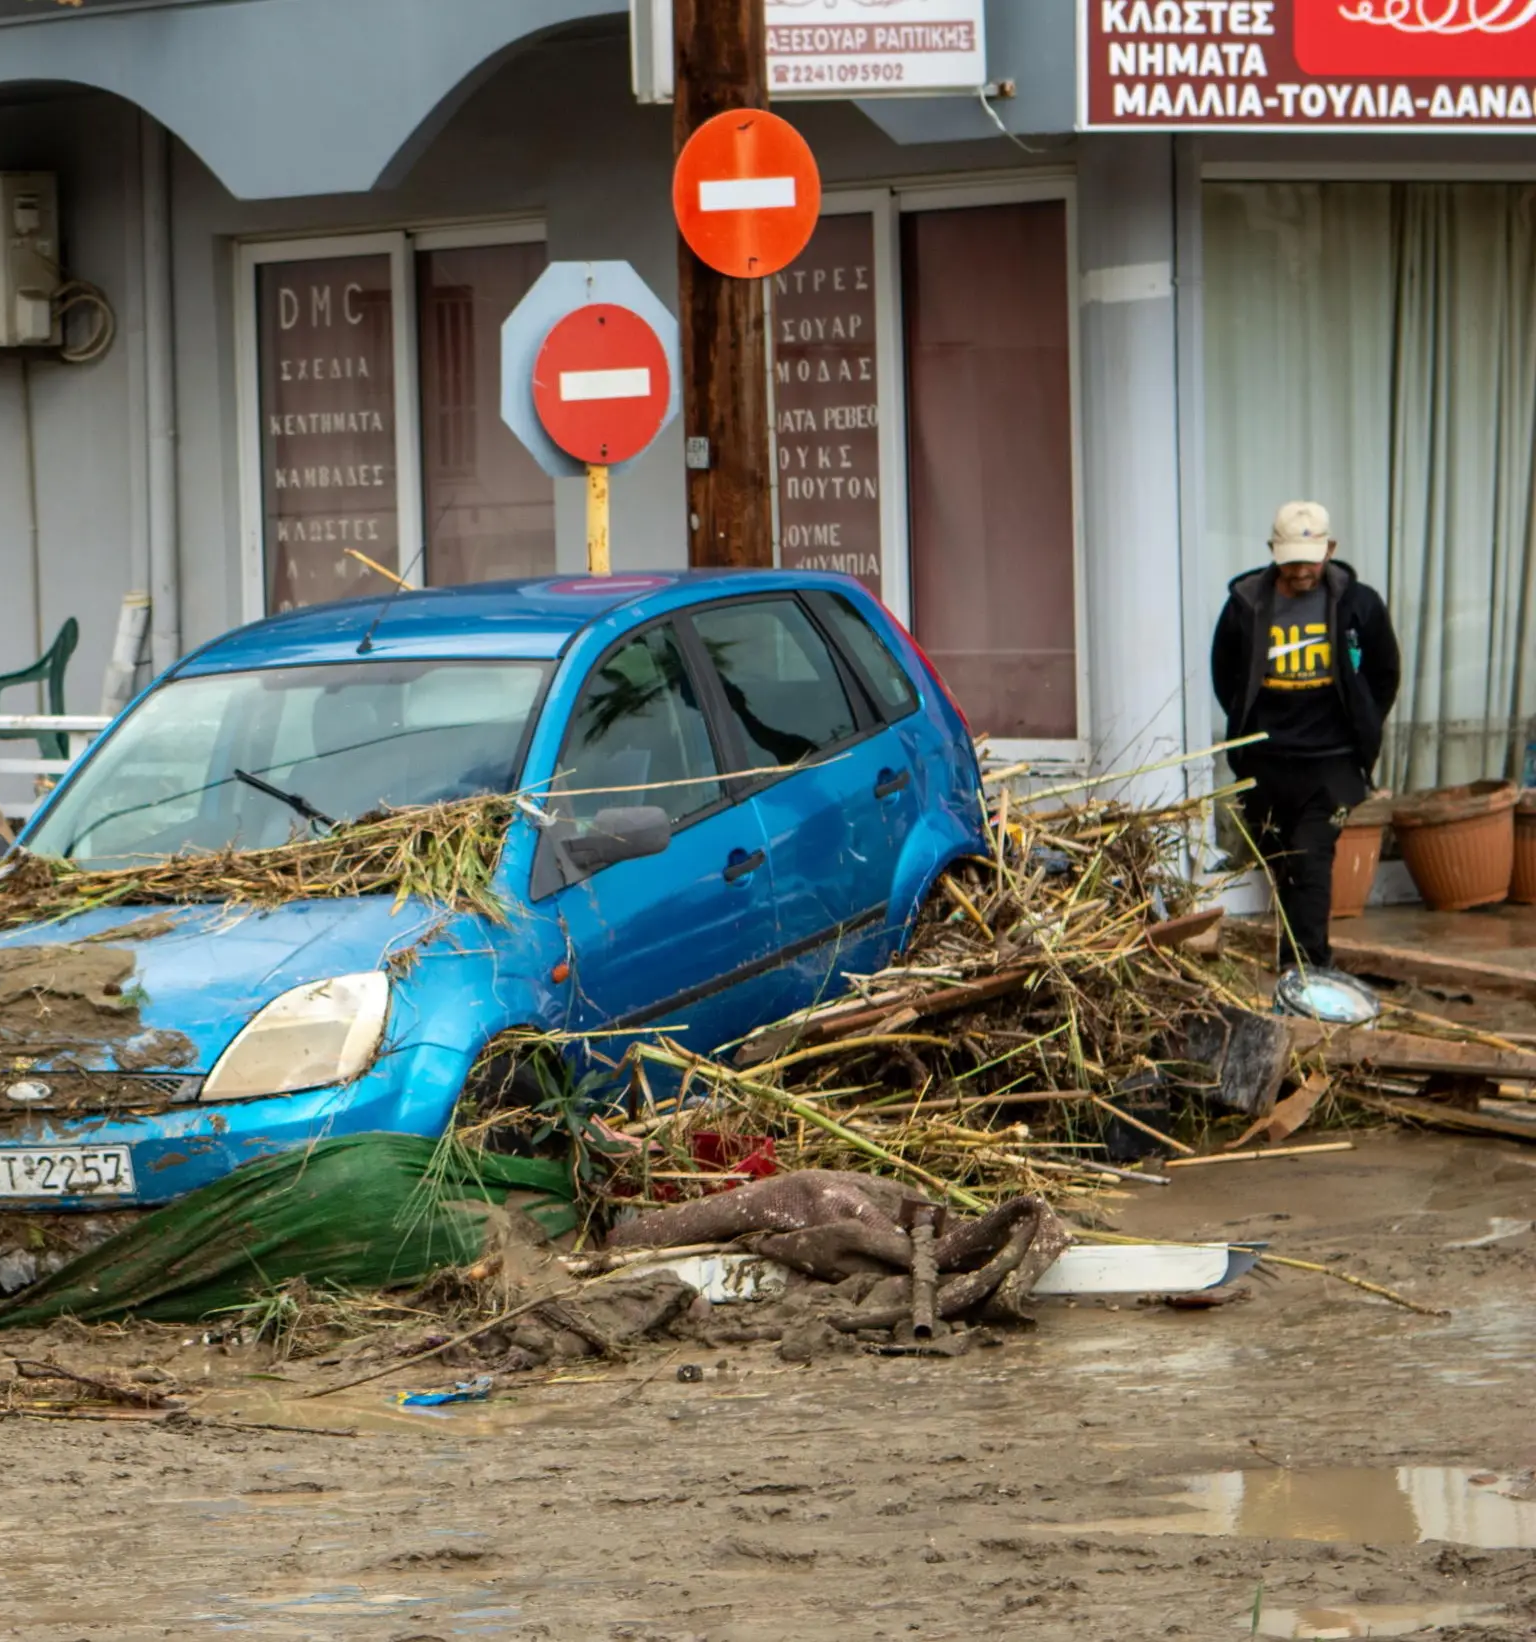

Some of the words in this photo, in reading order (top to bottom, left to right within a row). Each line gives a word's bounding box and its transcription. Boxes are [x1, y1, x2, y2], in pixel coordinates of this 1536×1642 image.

[1102, 1, 1275, 35] ΚΛΩΣΤΕΣ
[766, 27, 867, 51] ΑΞΕΣΟΥΑΡ
[874, 24, 971, 50] ΡΑΠΤΙΚΗΣ
[792, 62, 904, 83] 2241095902
[1108, 42, 1267, 77] ΝΗΜΑΤΑ
[1113, 83, 1536, 119] ΜΑΛΛΙΑ-ΤΟΥΛΙΑ-ΔΑΝΔ
[279, 282, 363, 330] DMC
[280, 356, 369, 381] ΣΧΕΔΙΑ
[270, 411, 383, 436] ΚΕΝΤΗΜΑΤΑ
[276, 465, 383, 489] ΚΑΜΒΑΔΕΣ
[277, 519, 379, 542] ΚΛΩΣΤΕΣ
